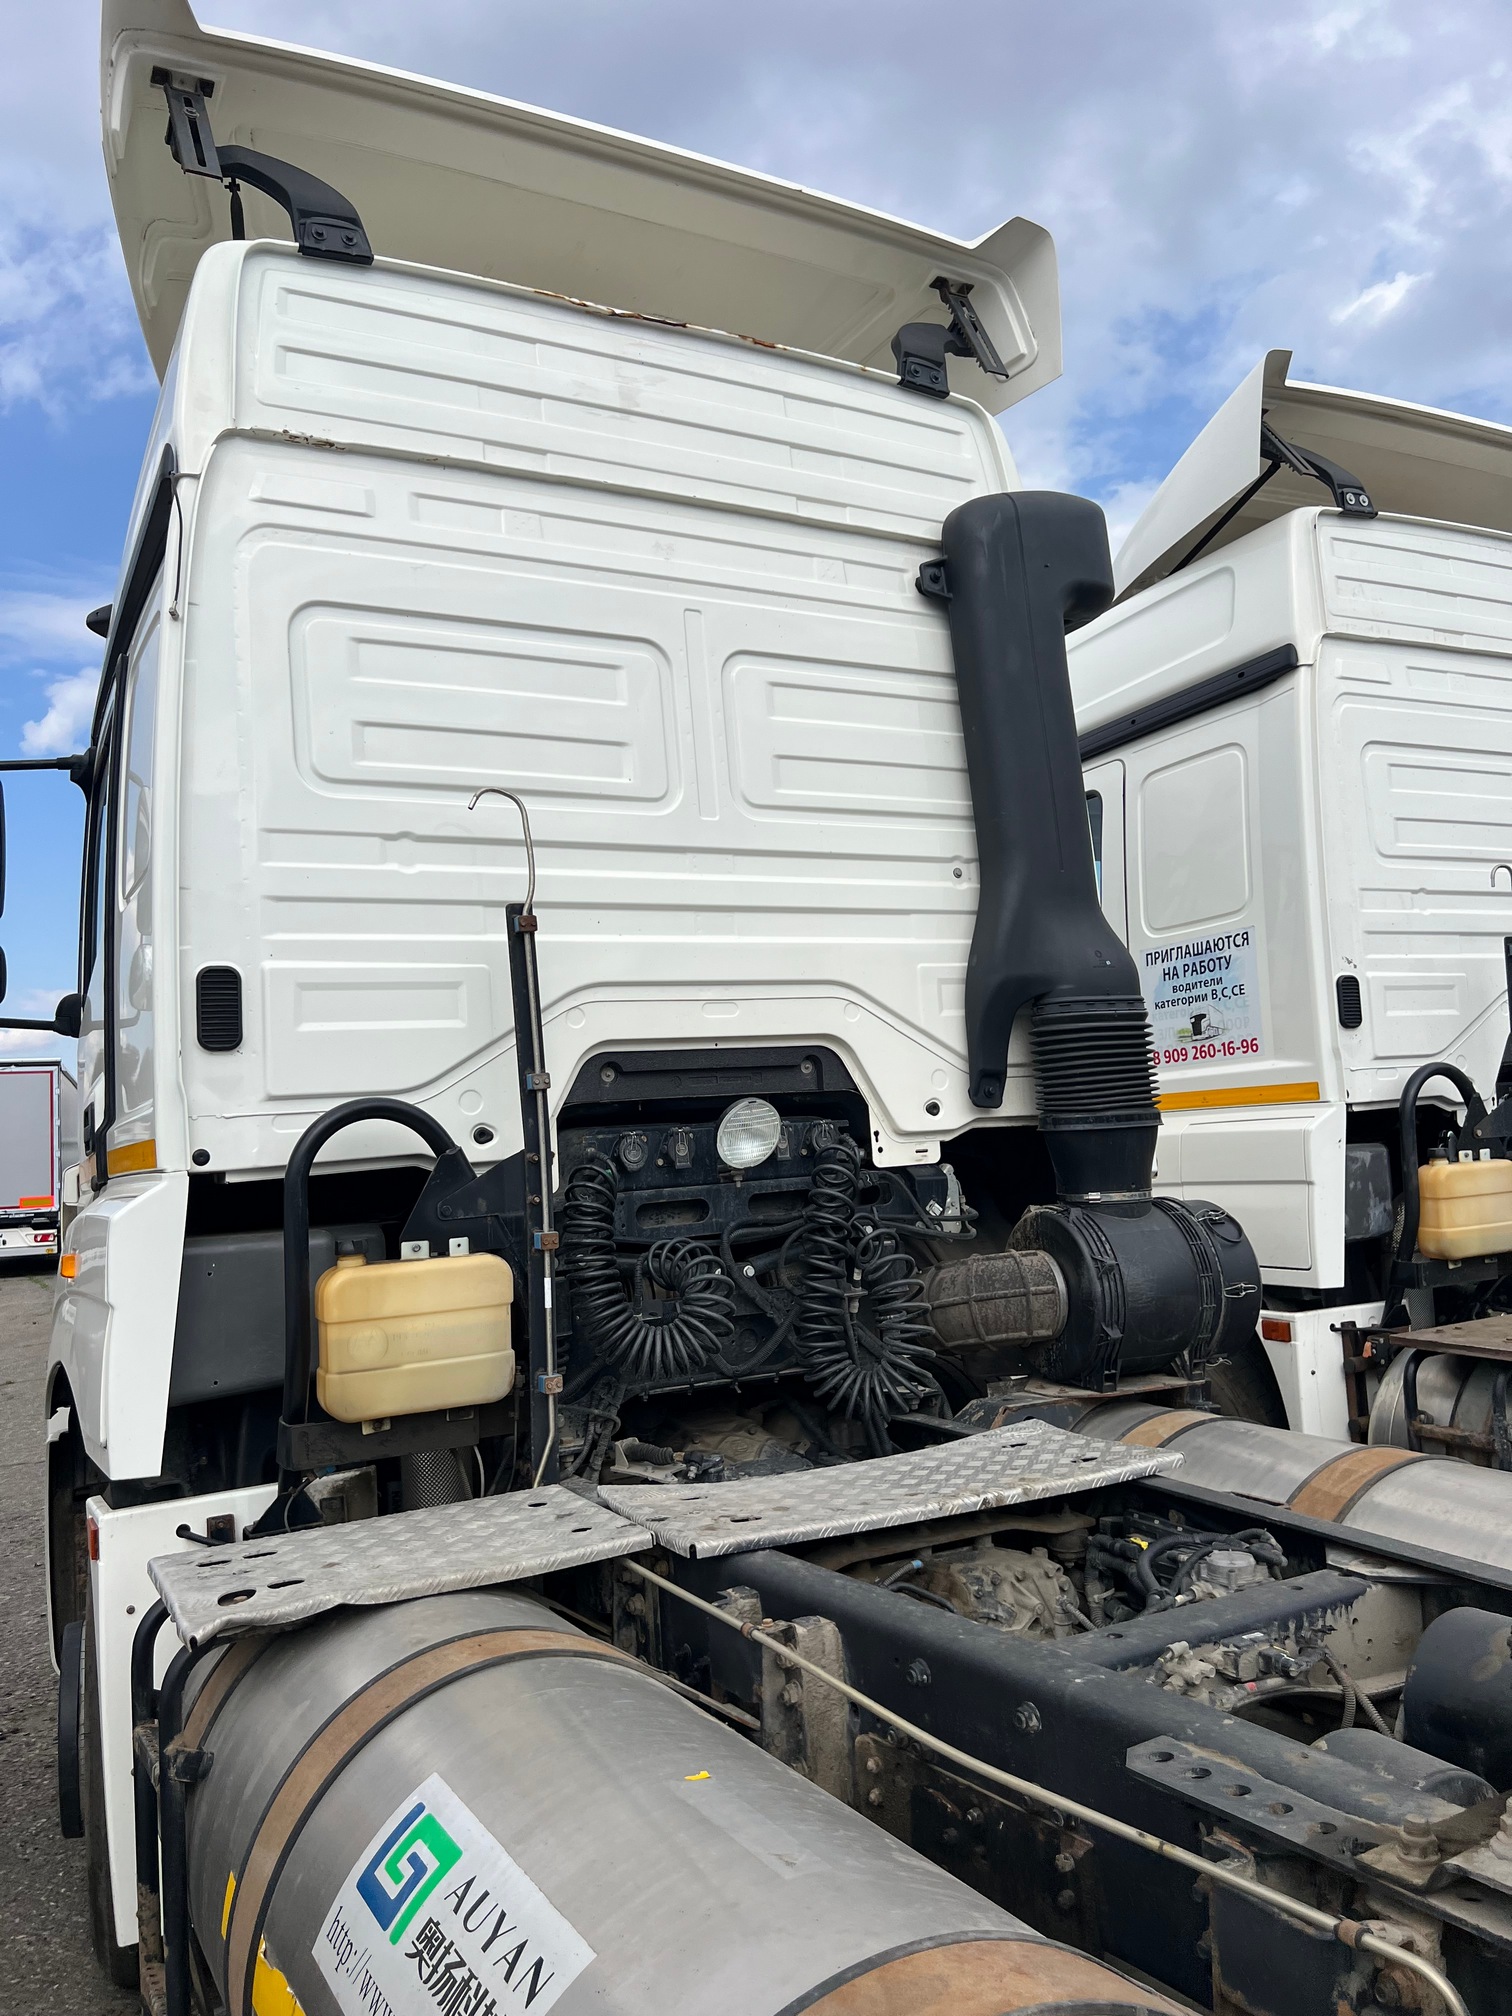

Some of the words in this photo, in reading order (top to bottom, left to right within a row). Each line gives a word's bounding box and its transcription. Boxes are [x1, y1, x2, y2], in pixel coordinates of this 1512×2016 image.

[1145, 931, 1250, 967] ПРИГЛАШАЮТСЯ
[1162, 965, 1180, 982] НА
[1183, 954, 1232, 978] РАБОТУ
[1172, 976, 1223, 994] водители
[1154, 992, 1208, 1010] категории
[1152, 1051, 1161, 1065] 8
[1163, 1047, 1189, 1064] 909
[1191, 1037, 1259, 1060] 260-16-96
[443, 1874, 555, 2010] AUYAN
[404, 1916, 508, 2016] 奥扬科
